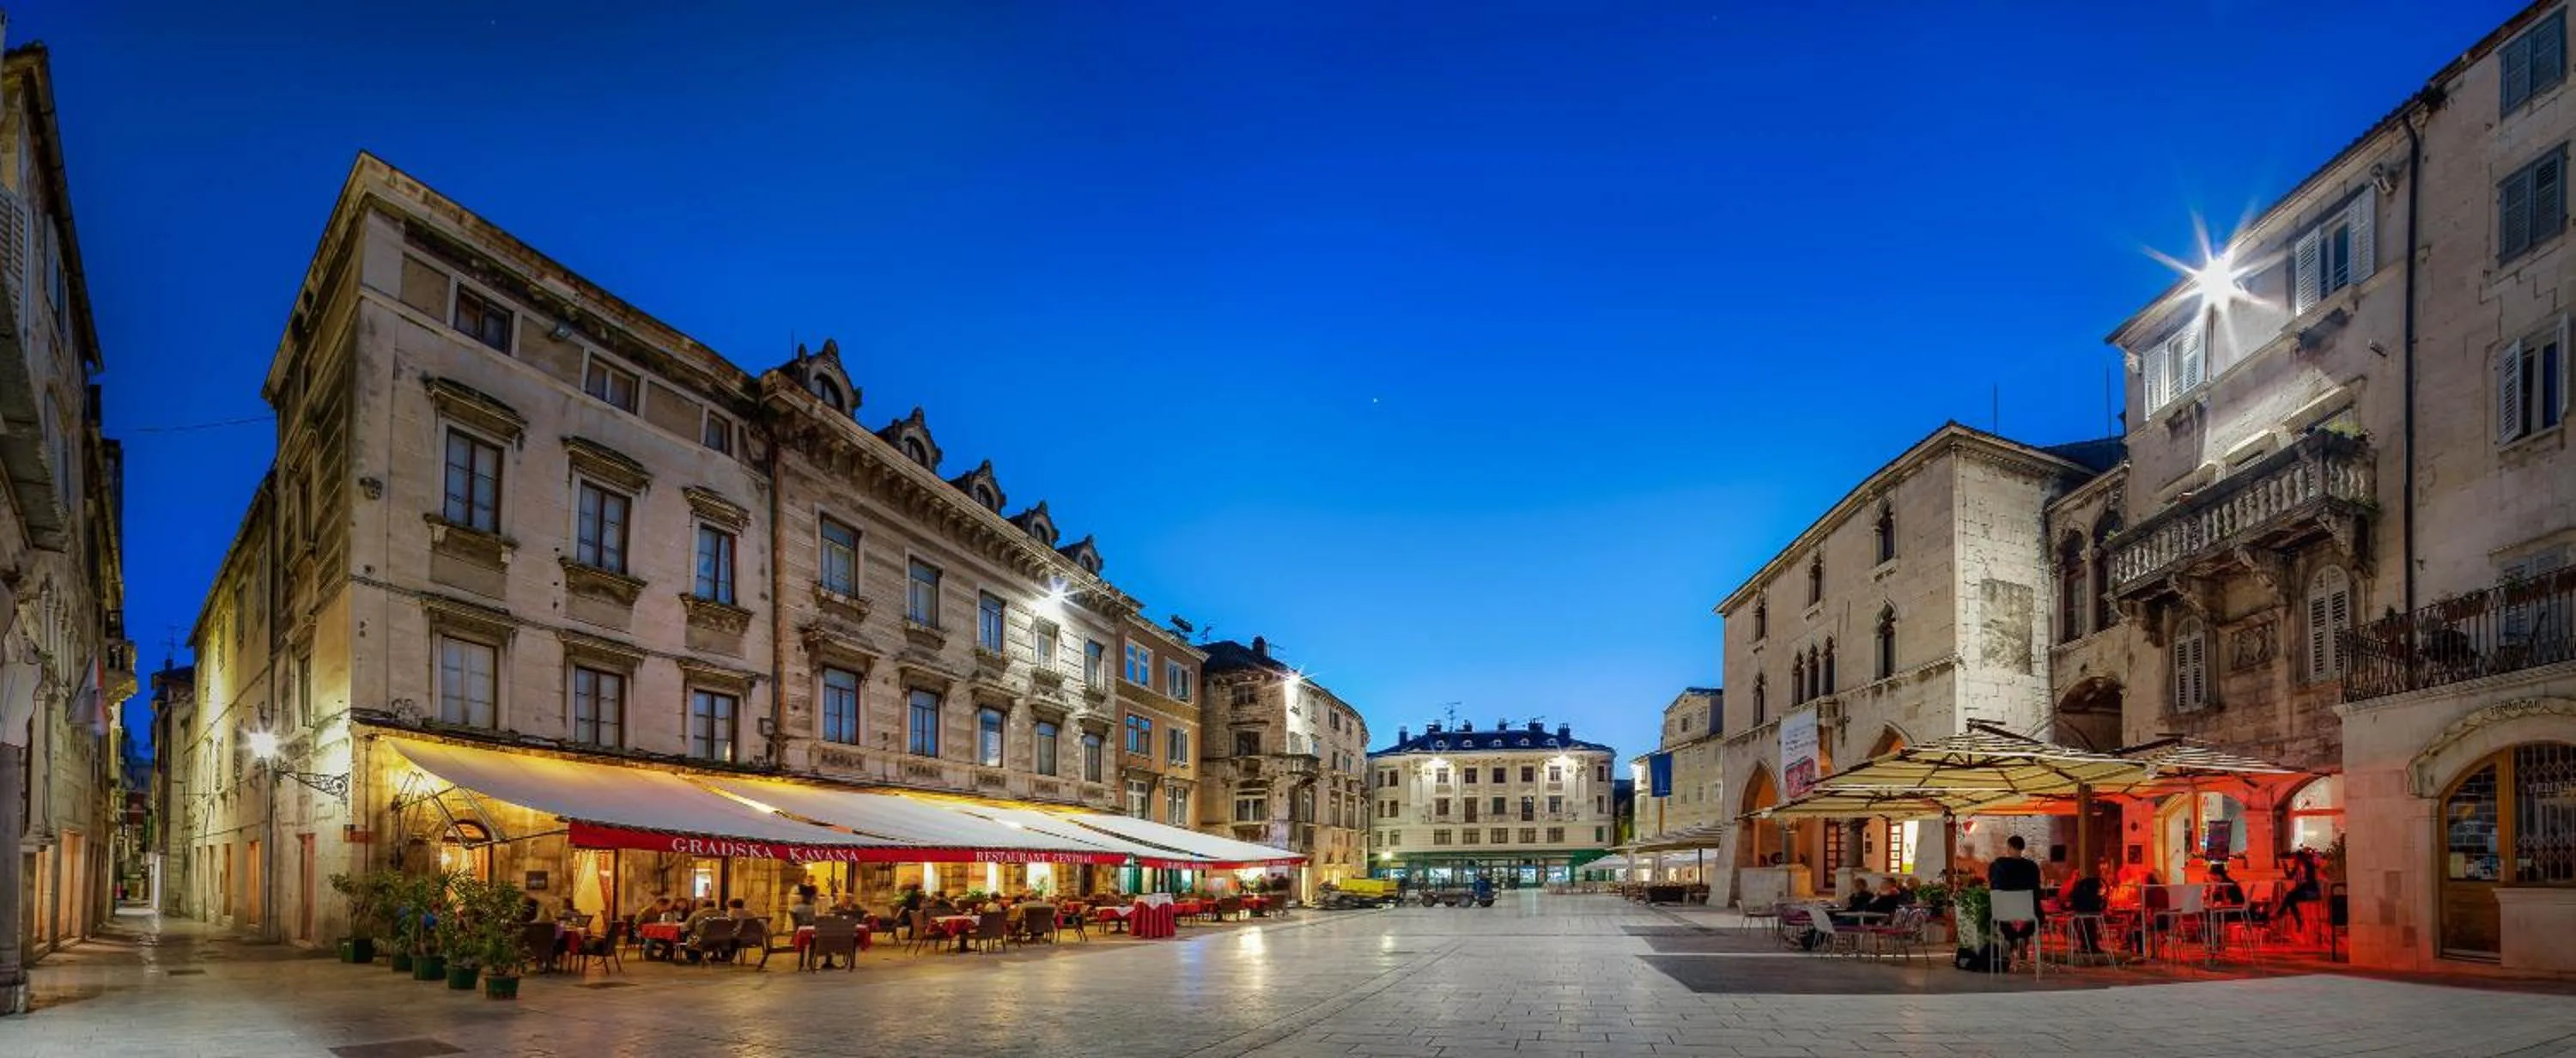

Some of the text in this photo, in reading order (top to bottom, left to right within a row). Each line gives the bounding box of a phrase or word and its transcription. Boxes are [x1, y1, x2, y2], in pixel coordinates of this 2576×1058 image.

[671, 837, 859, 862] GRADSKA KAVANA
[975, 851, 1048, 863] RESTAURANT
